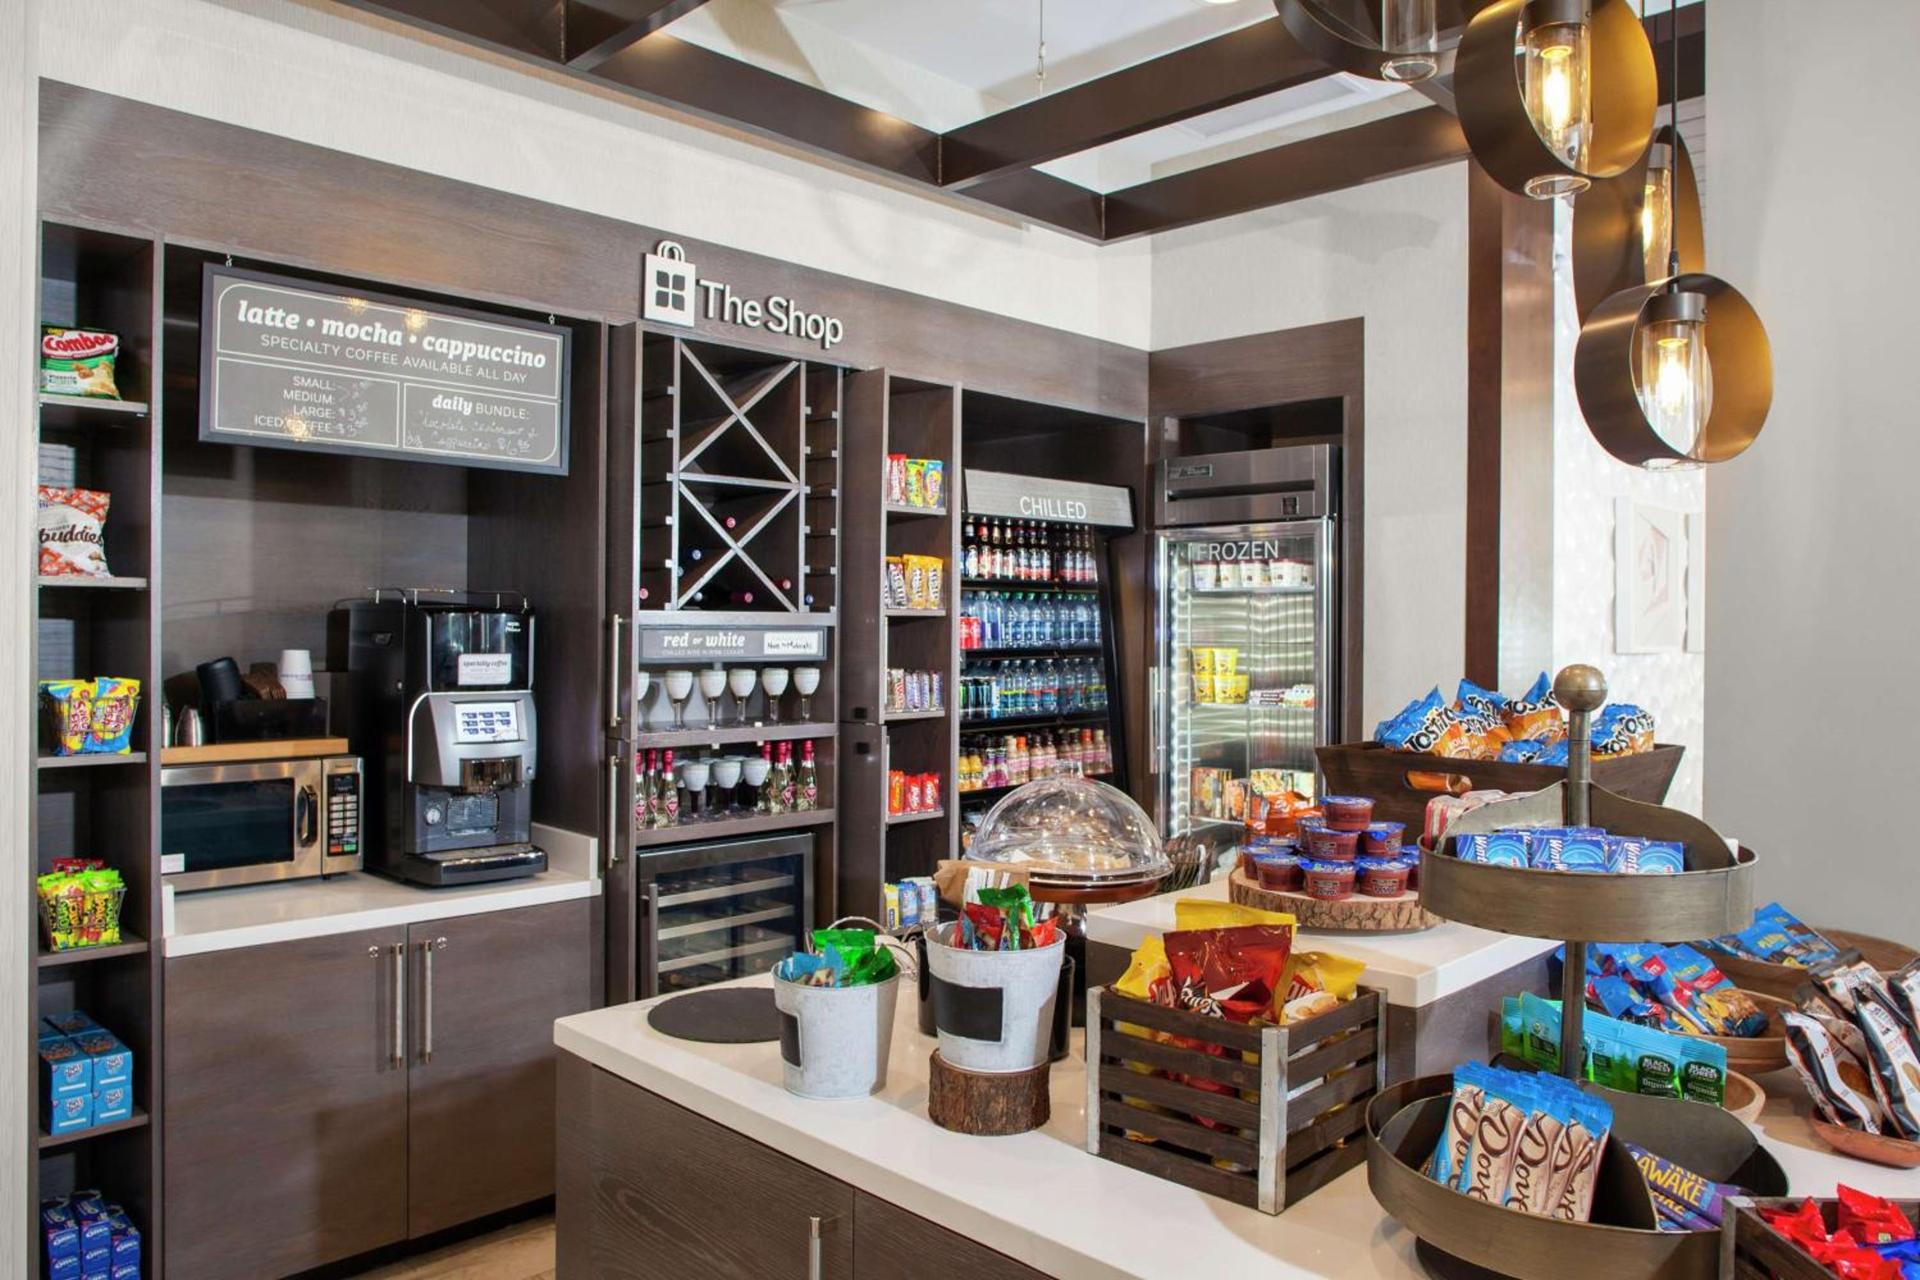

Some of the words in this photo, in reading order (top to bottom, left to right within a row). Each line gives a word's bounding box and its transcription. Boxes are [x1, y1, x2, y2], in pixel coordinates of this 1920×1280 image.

[699, 279, 761, 327] The
[767, 295, 843, 348] Shop
[237, 300, 300, 329] latte
[321, 317, 402, 346] mocha
[422, 334, 546, 368] cappuccino
[260, 334, 341, 357] SPECIALTY
[345, 347, 398, 365] COFFEE
[402, 355, 473, 376] AVAILABLE
[476, 367, 499, 380] ALL
[503, 371, 528, 384] DAY
[432, 394, 473, 416] daily
[254, 415, 284, 428] ICED
[1019, 496, 1087, 520] CHILLED
[1199, 540, 1279, 561] FROZEN
[663, 632, 690, 648] red
[705, 632, 746, 648] white
[1637, 1154, 1705, 1208] AWAKE
